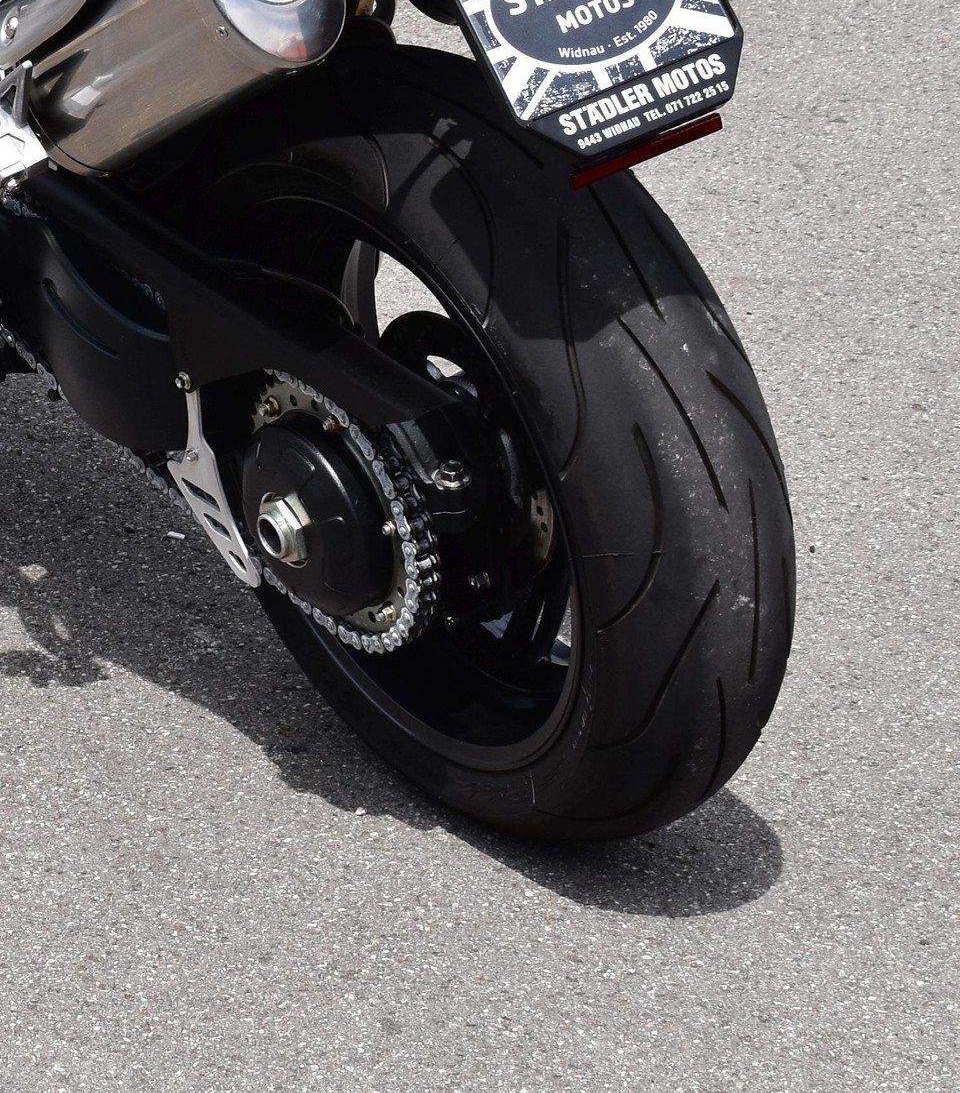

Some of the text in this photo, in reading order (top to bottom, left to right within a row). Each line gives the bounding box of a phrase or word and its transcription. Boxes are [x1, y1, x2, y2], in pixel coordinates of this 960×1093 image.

[558, 10, 658, 58] Widnau Est. 1980
[558, 53, 727, 136] STÄDLER MOTOS
[577, 132, 603, 149] 9443
[601, 115, 641, 139] WIDNAU
[665, 99, 684, 114] 071
[683, 91, 703, 106] 722
